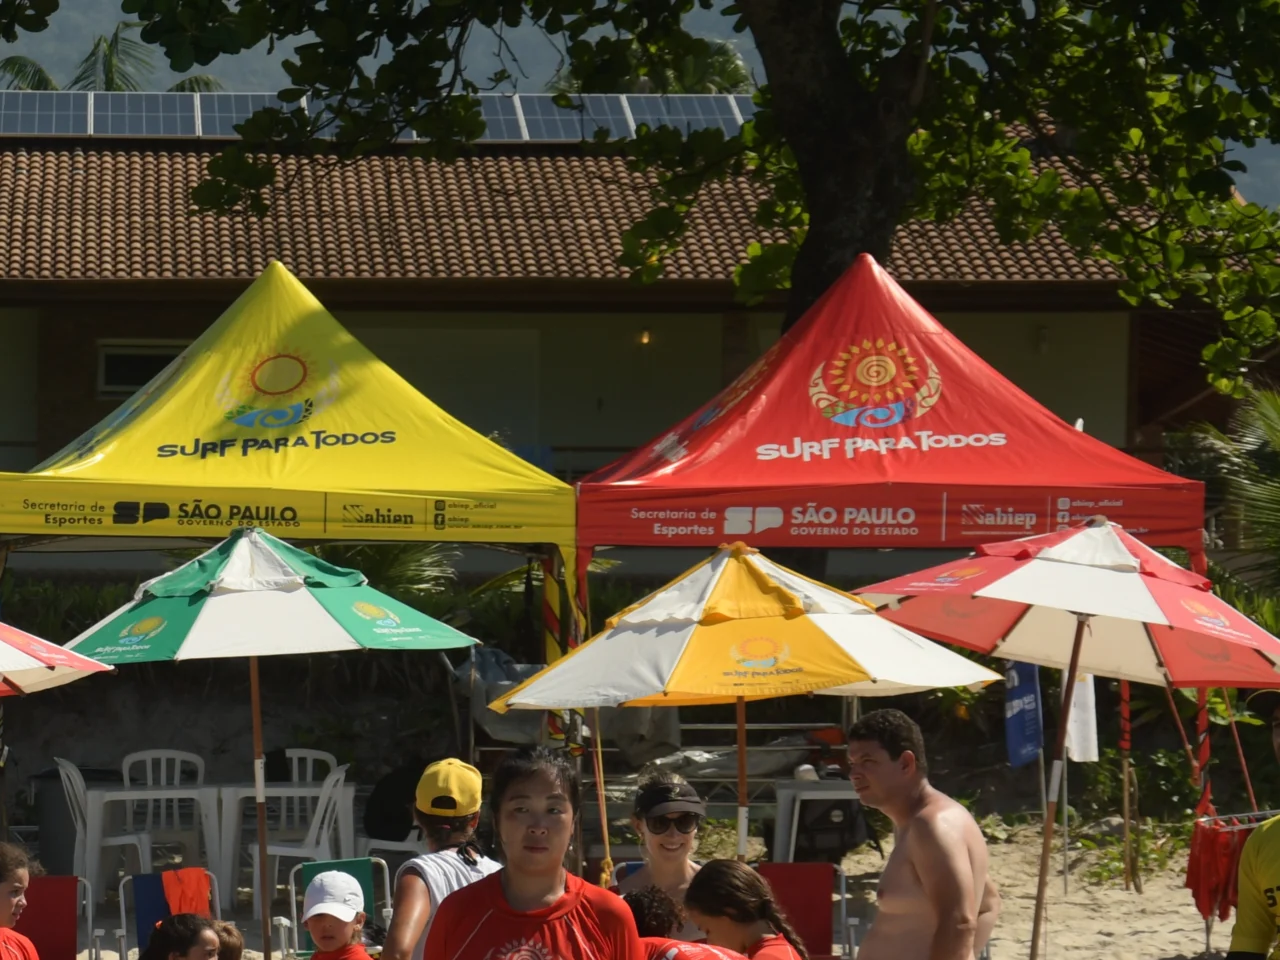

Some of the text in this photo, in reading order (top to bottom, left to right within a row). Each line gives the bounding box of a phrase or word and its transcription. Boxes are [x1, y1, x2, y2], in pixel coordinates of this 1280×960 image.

[157, 430, 397, 460] SURF PARA TODOS
[756, 431, 1008, 461] SURF PARA TODOS
[22, 499, 106, 513] Secretaria de
[178, 500, 298, 521] SÃO PAULO
[44, 514, 103, 527] Esportes
[631, 507, 717, 520] Secretaria de
[791, 503, 915, 525] SÃO PAULO
[237, 519, 255, 527] DO
[259, 519, 301, 527] ESTADO
[653, 523, 714, 537] Esportes
[790, 527, 918, 535] GOVERNO DO ESTADO
